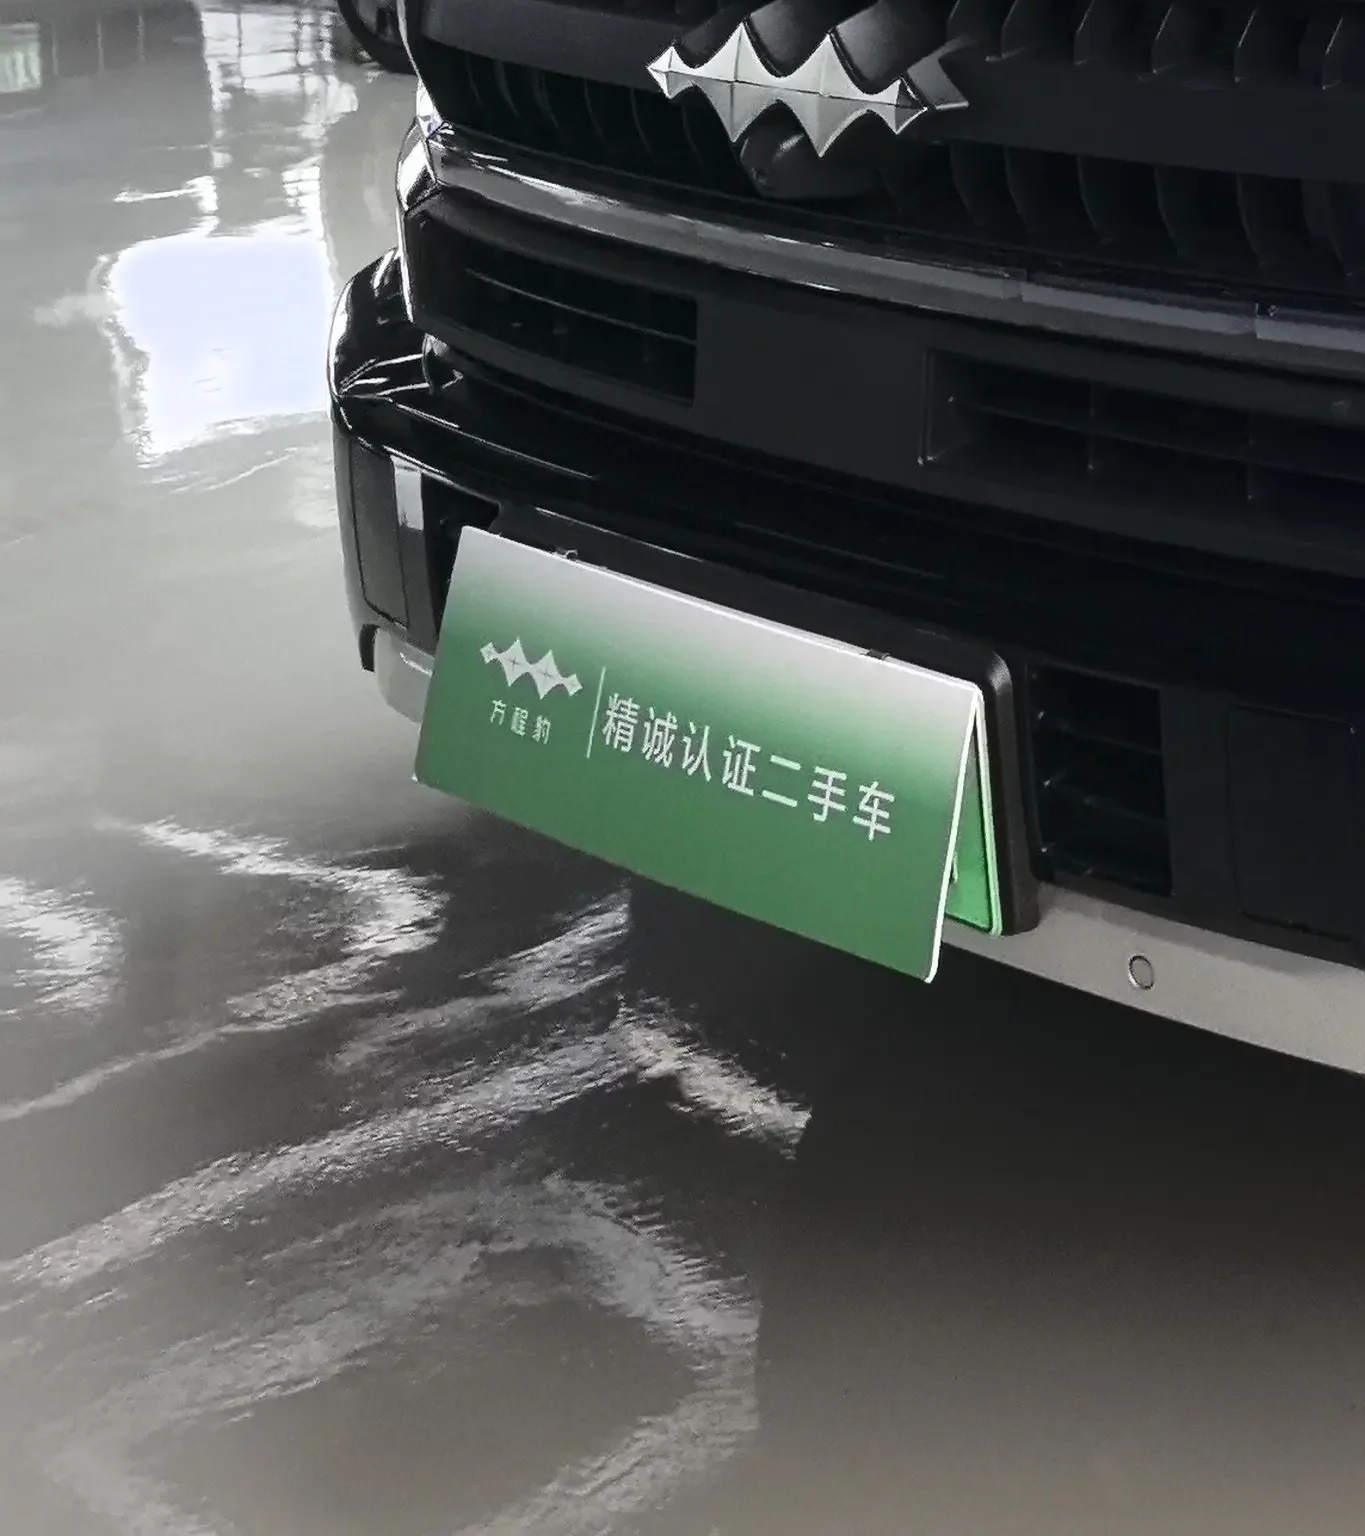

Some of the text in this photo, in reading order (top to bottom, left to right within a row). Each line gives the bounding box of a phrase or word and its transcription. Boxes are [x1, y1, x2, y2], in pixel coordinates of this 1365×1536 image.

[490, 699, 551, 744] 方程豹
[602, 693, 895, 840] 精诚认证二手车
